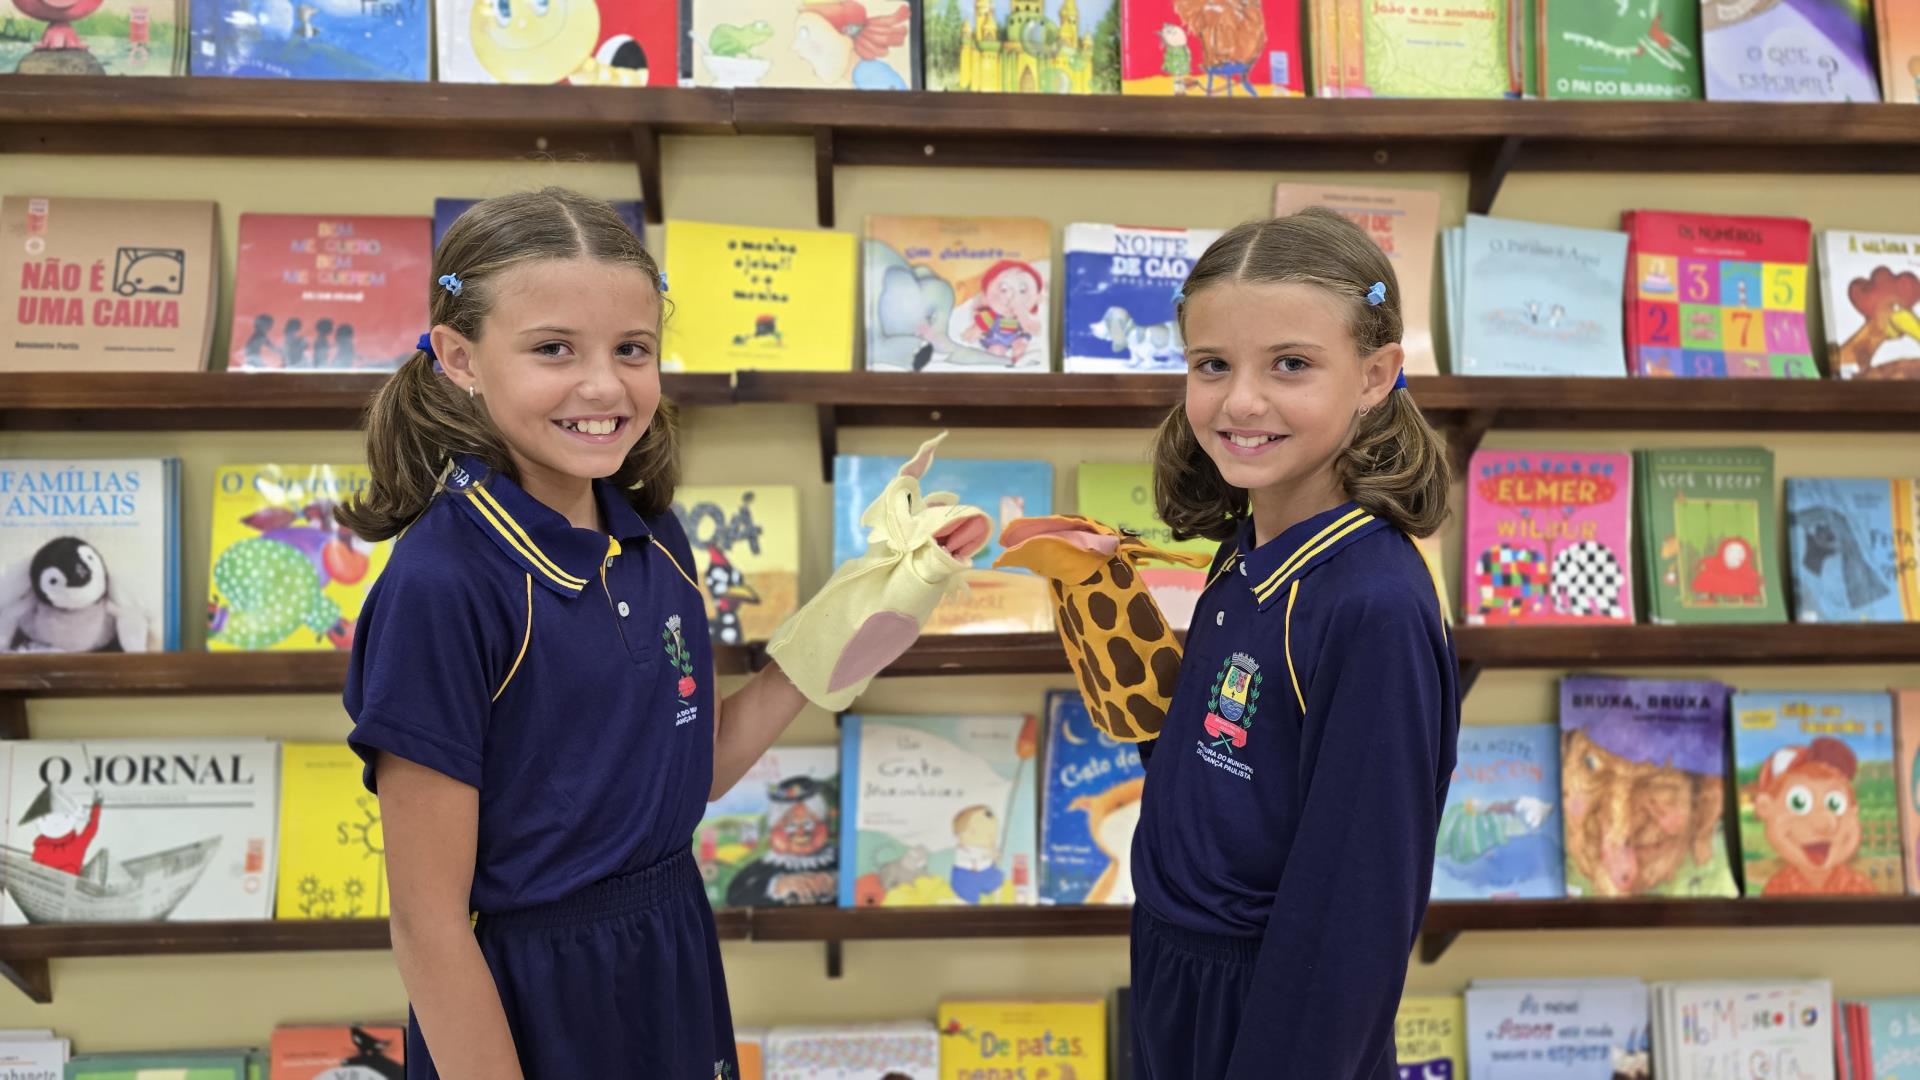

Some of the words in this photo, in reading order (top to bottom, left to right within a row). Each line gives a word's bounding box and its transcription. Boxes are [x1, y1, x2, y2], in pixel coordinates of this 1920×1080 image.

[1444, 5, 1495, 20] animais
[1556, 78, 1570, 93] O
[1594, 81, 1618, 95] DO
[1115, 235, 1188, 257] NOITE
[21, 257, 81, 291] NÃO
[89, 260, 104, 292] É
[1112, 256, 1141, 276] DE
[1688, 263, 1709, 300] 3
[1773, 269, 1793, 305] 5
[17, 297, 85, 326] UMA
[92, 299, 179, 328] CAIXA
[1649, 307, 1670, 342] 2
[1731, 312, 1752, 348] 7
[0, 465, 140, 493] FAMÍLIAS
[1498, 478, 1597, 503] ELMER
[6, 495, 136, 516] ANIMAIS
[1572, 693, 1641, 711] BRUXA,
[1647, 694, 1711, 709] BRUXA
[39, 756, 72, 785] O
[84, 755, 254, 786] JORNAL
[1217, 753, 1227, 762] DO
[1223, 763, 1251, 781] PAULISTA
[981, 1031, 1010, 1059] De
